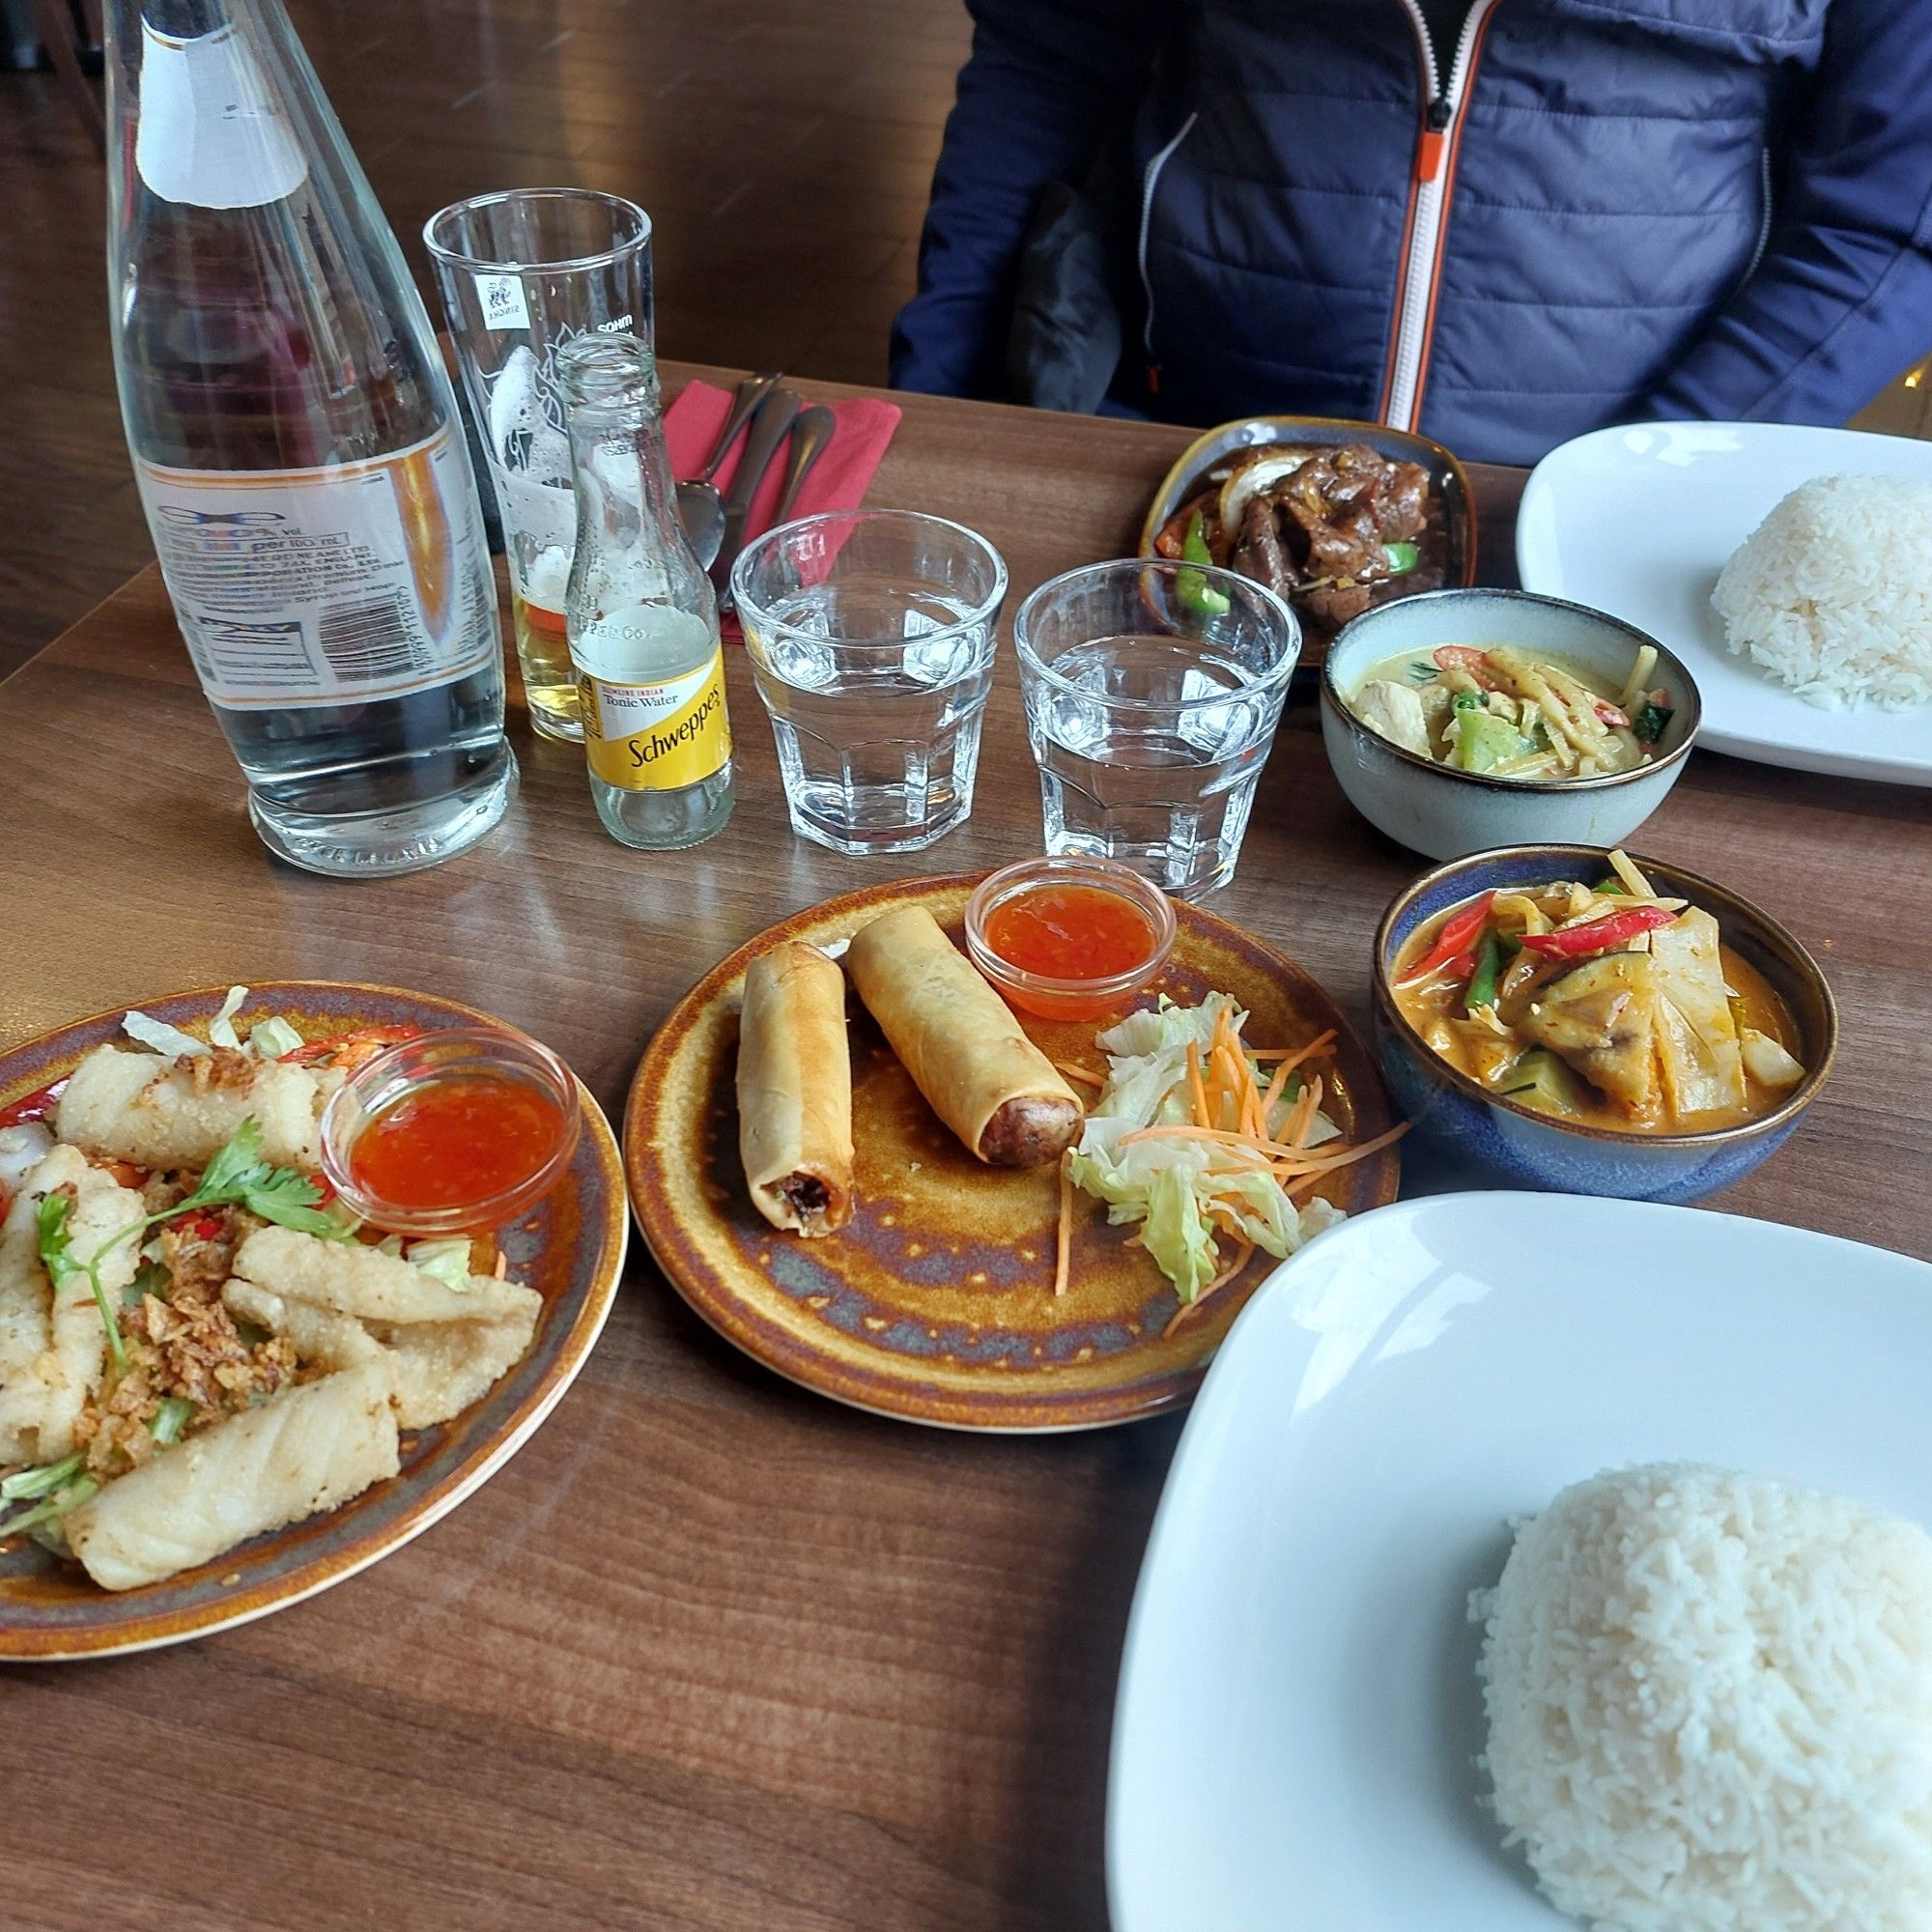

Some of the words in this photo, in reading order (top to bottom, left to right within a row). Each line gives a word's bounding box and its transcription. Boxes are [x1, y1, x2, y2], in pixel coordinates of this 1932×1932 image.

[602, 694, 639, 708] Tonic
[638, 695, 679, 707] Water
[628, 683, 721, 768] Schweppes
